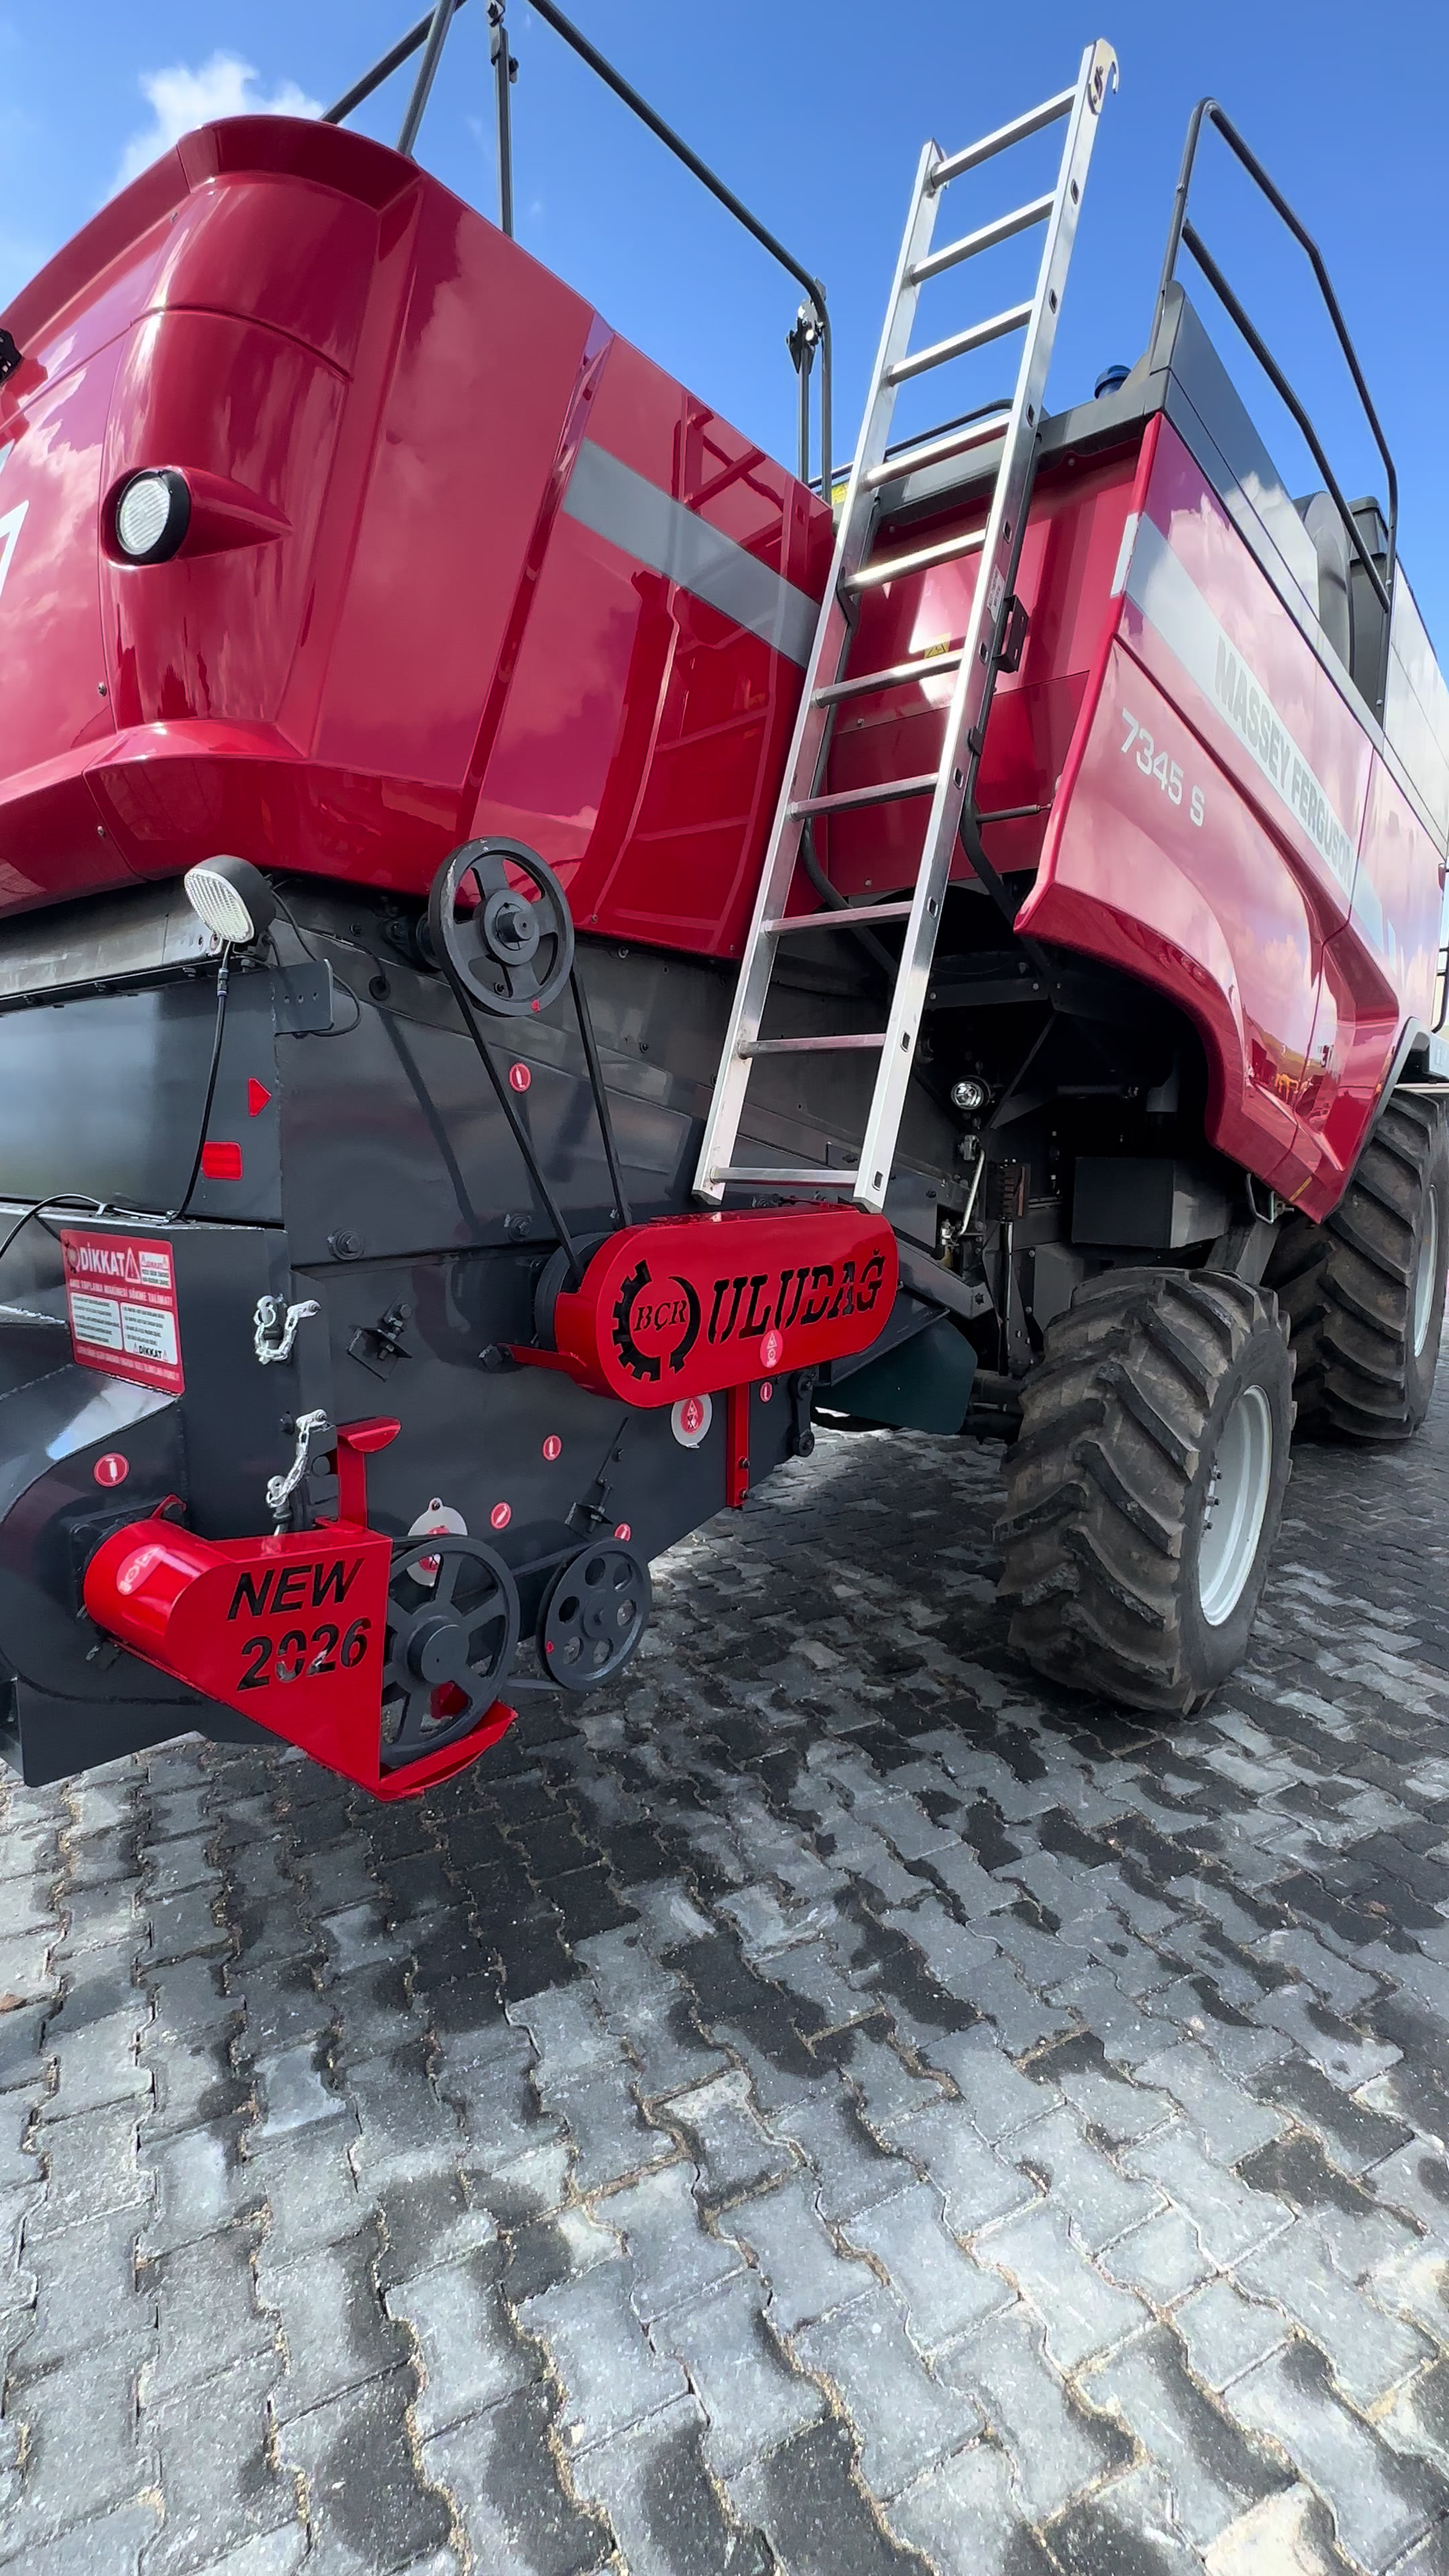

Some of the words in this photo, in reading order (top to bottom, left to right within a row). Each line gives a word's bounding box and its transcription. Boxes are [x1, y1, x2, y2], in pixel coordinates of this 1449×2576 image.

[1121, 707, 1184, 805] 7345
[1190, 785, 1205, 826] S
[1214, 635, 1291, 790] MASSEY
[1291, 757, 1354, 884] FERGUSON
[80, 1241, 125, 1277] DİKKAT
[708, 1248, 886, 1344] ULUDAĞ
[227, 1556, 365, 1621] NEW
[237, 1617, 372, 1693] 2026
